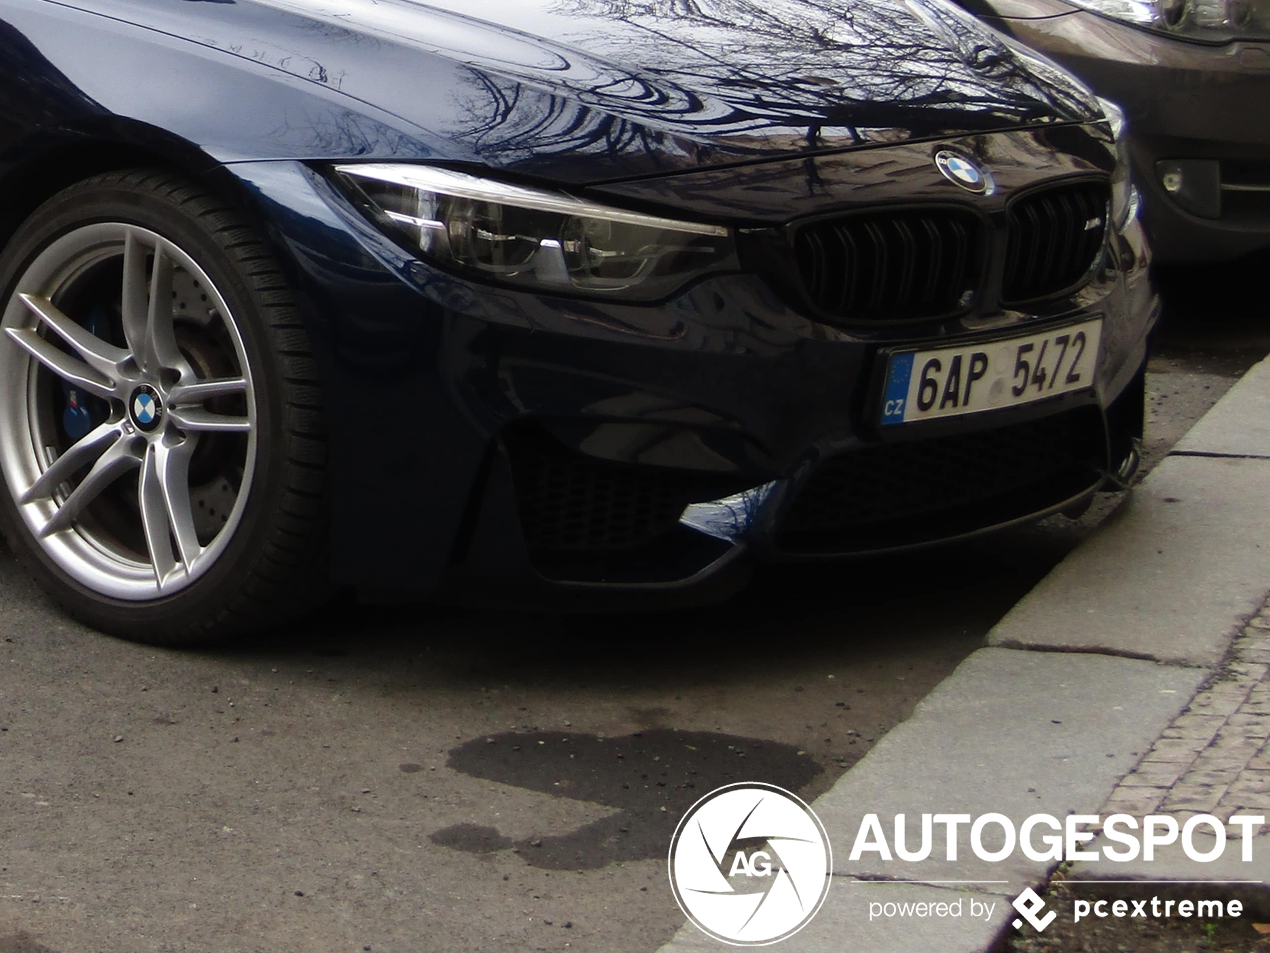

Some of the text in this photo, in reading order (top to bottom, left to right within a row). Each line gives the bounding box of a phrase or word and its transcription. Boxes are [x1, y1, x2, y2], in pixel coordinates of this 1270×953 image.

[917, 331, 1087, 411] 6AP 5472
[884, 399, 904, 416] CZ
